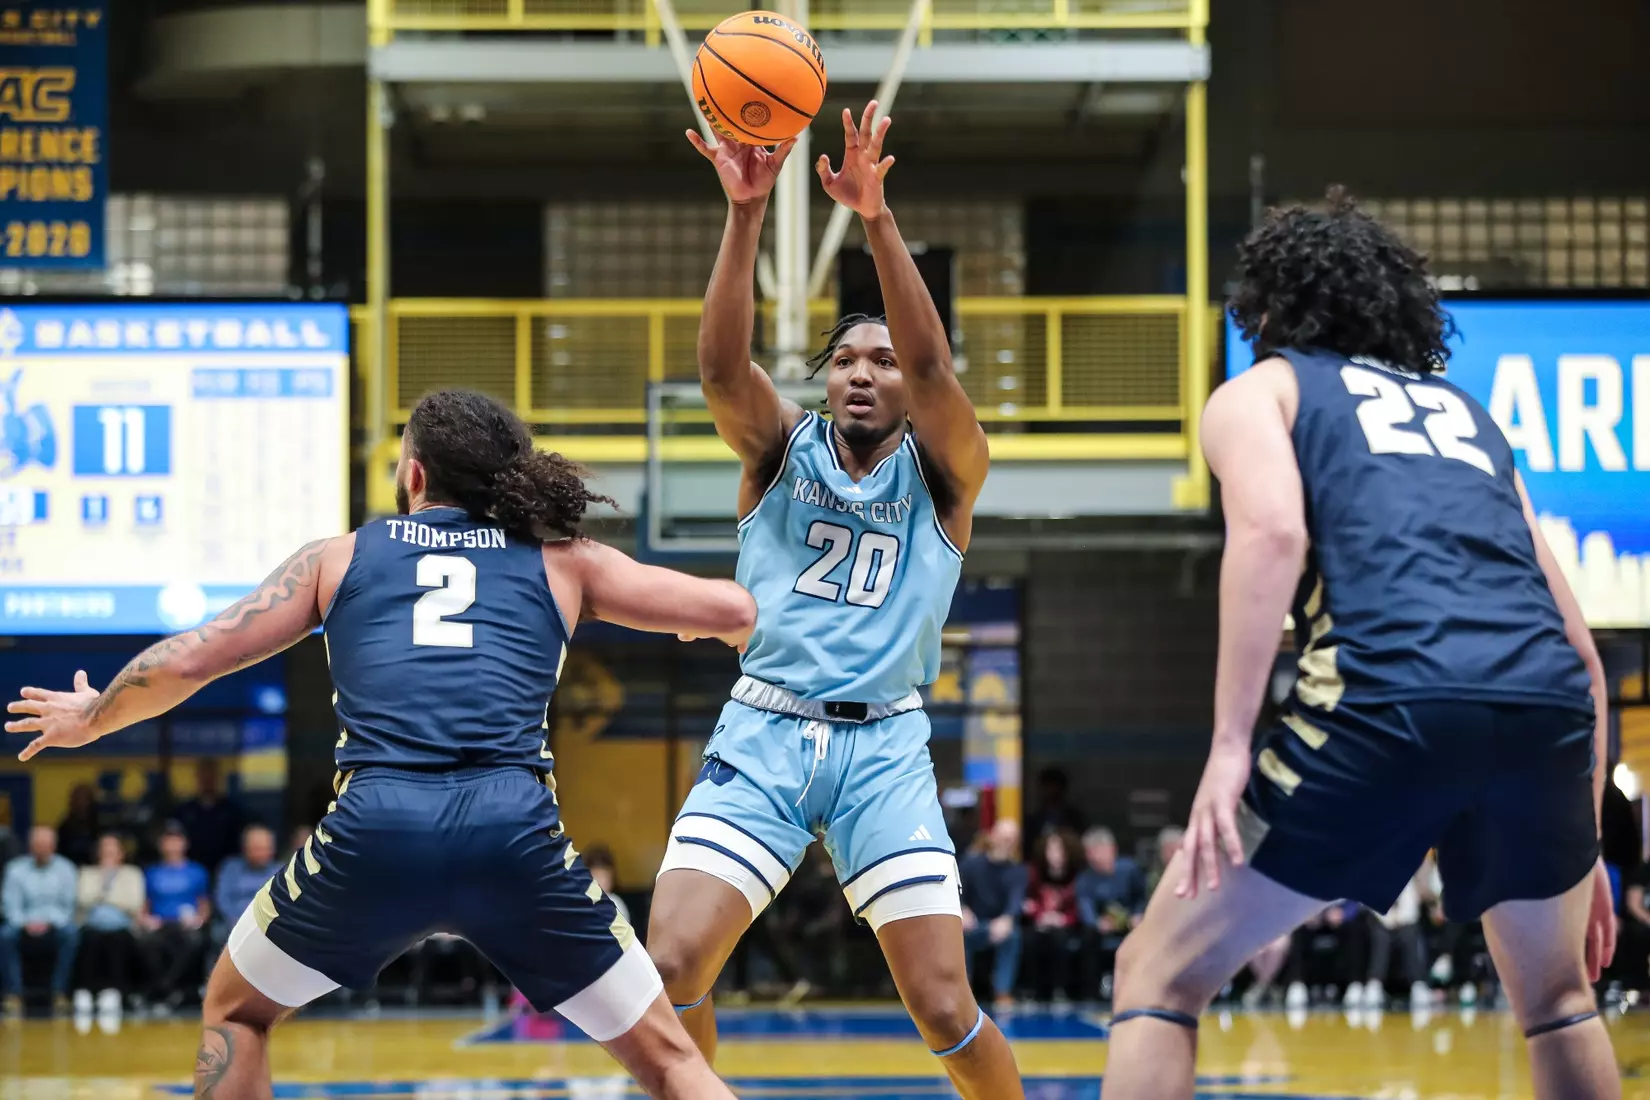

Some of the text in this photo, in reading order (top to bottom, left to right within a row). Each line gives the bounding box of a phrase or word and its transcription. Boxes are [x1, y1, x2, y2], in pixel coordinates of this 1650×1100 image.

[35, 319, 330, 348] BASKETBALL
[98, 408, 145, 474] 11
[1340, 365, 1496, 477] 22
[1489, 354, 1650, 472] AR
[386, 519, 507, 549] THOMPSON
[870, 493, 912, 523] CITY
[413, 554, 477, 648] 2
[792, 520, 900, 609] 20
